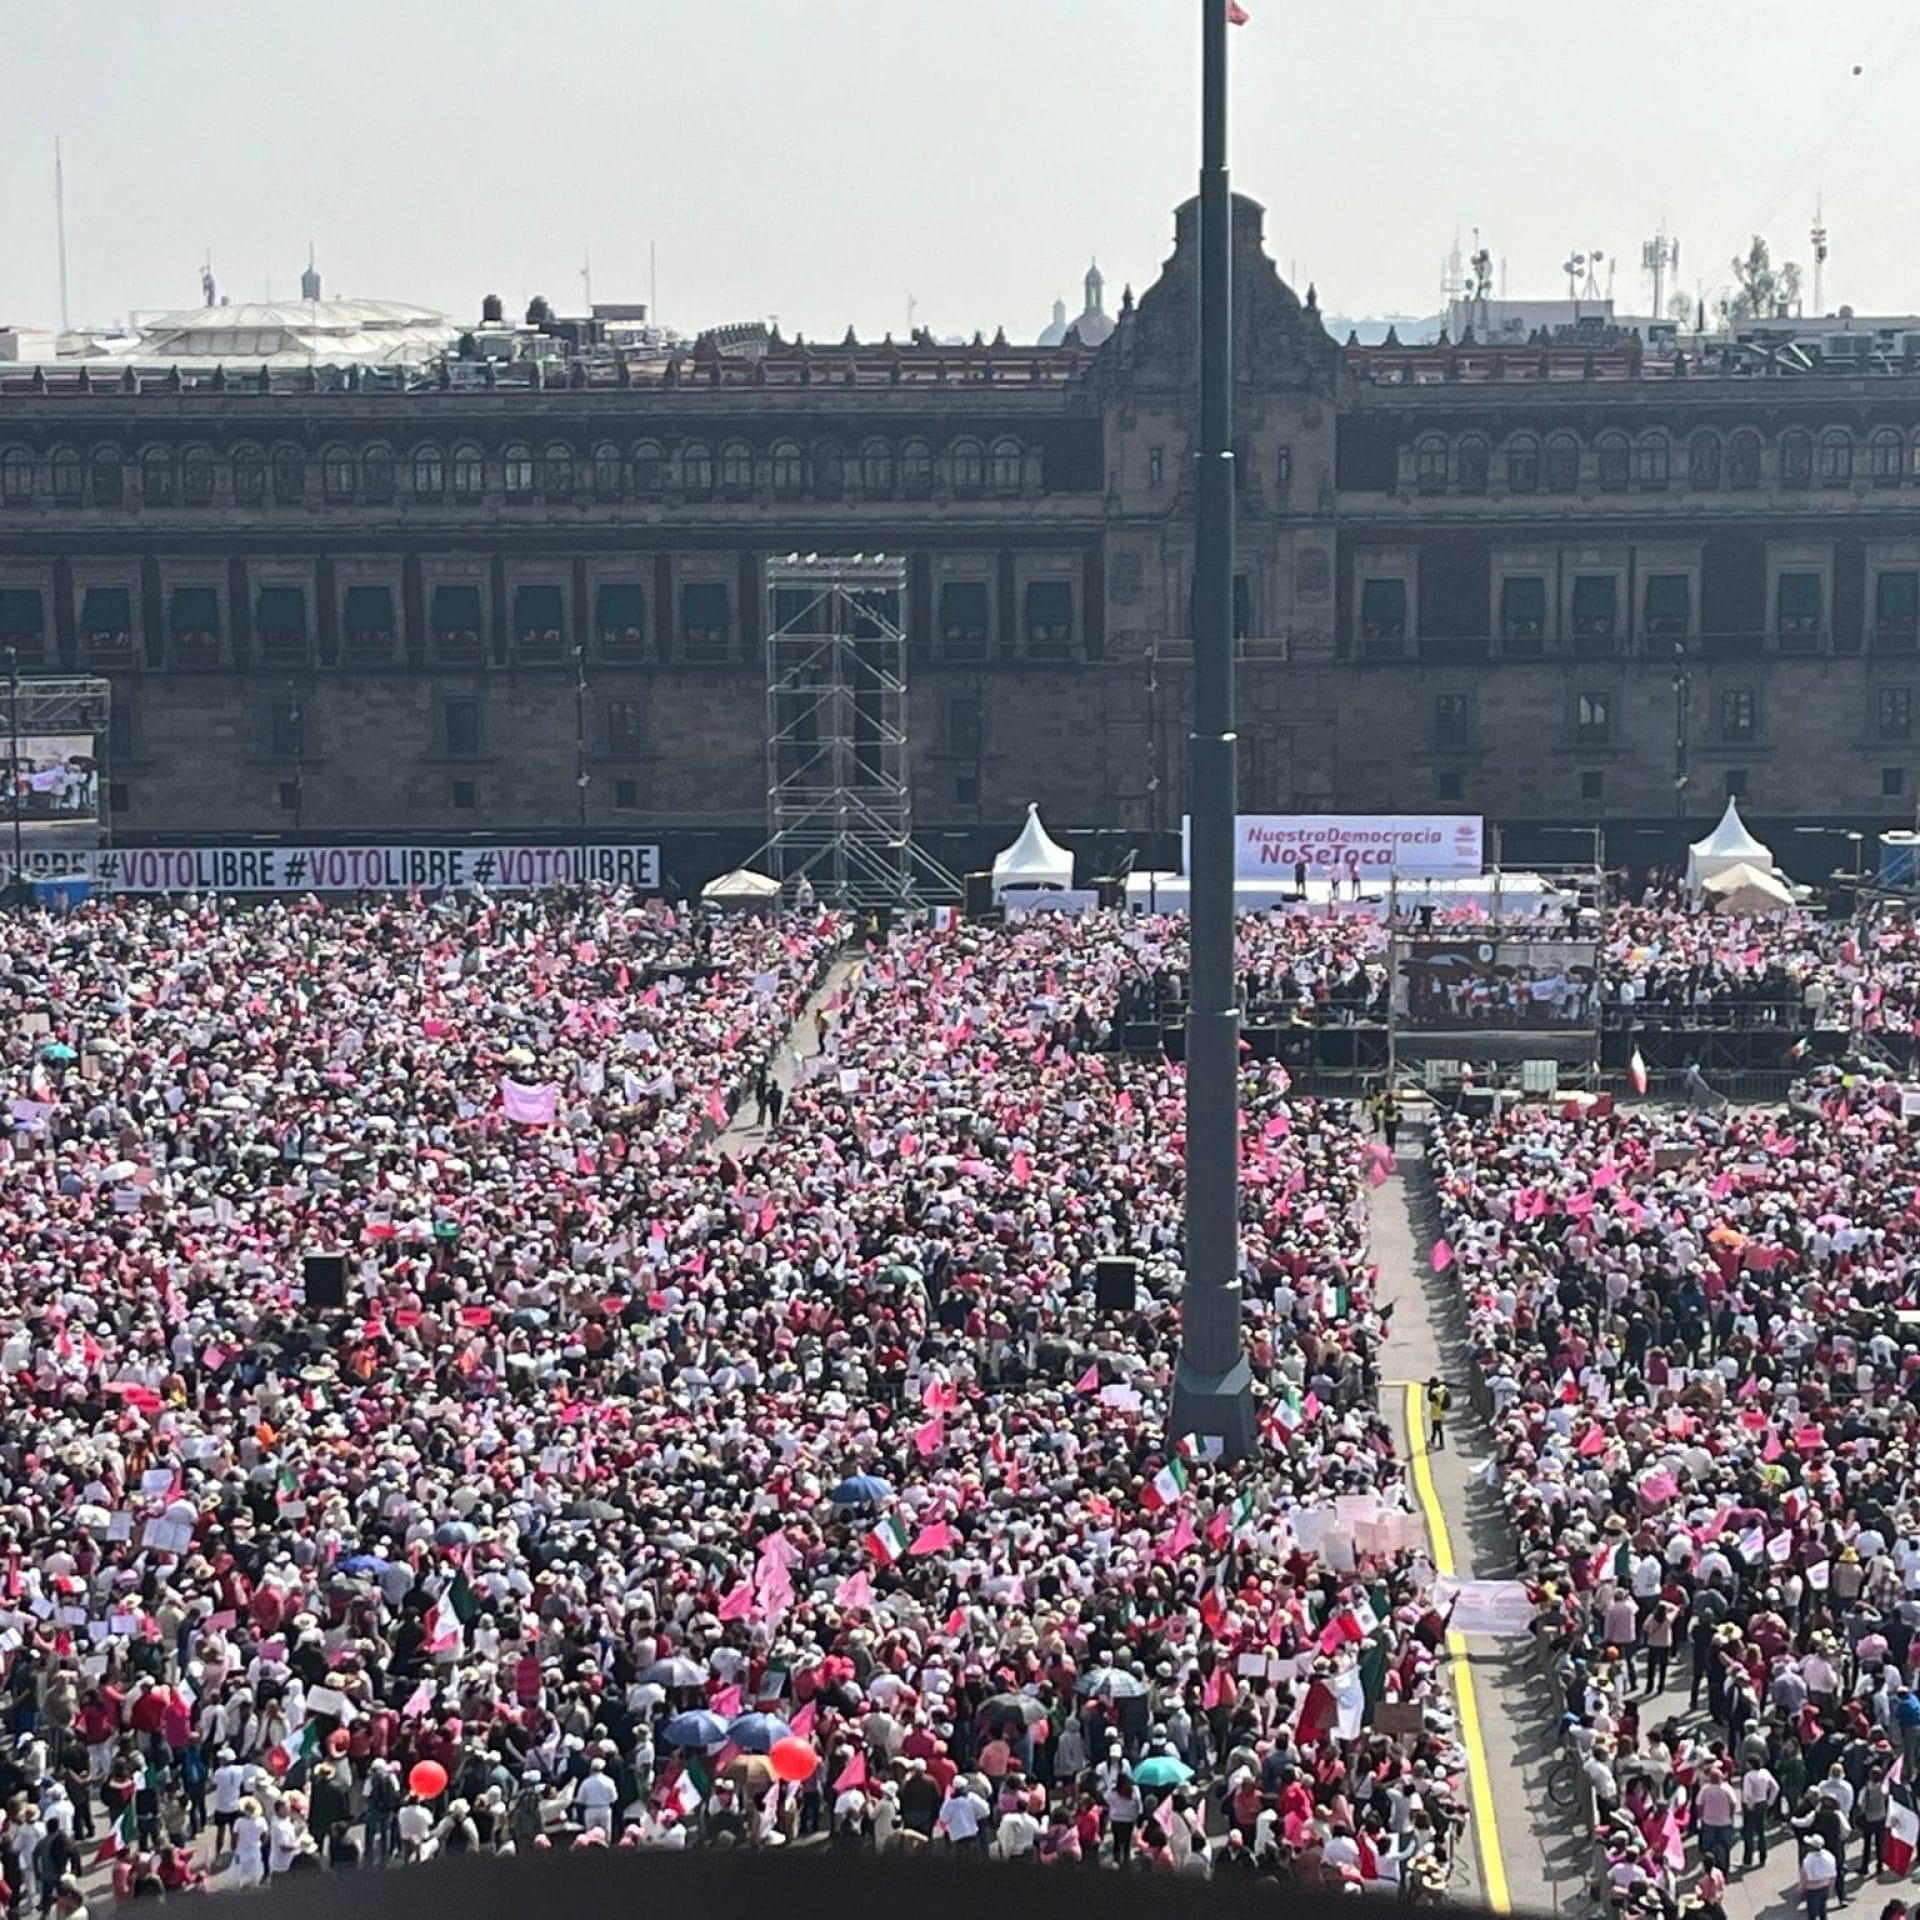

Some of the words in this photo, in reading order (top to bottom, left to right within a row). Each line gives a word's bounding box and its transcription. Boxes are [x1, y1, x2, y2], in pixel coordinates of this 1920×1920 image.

[1248, 827, 1442, 843] NuestraDemocracia
[1260, 844, 1393, 865] NoSeToca
[97, 851, 275, 888] #VOTOLIBRE
[284, 849, 464, 886] #VOTOLIBRE
[473, 848, 651, 884] #VOTOLIBRE
